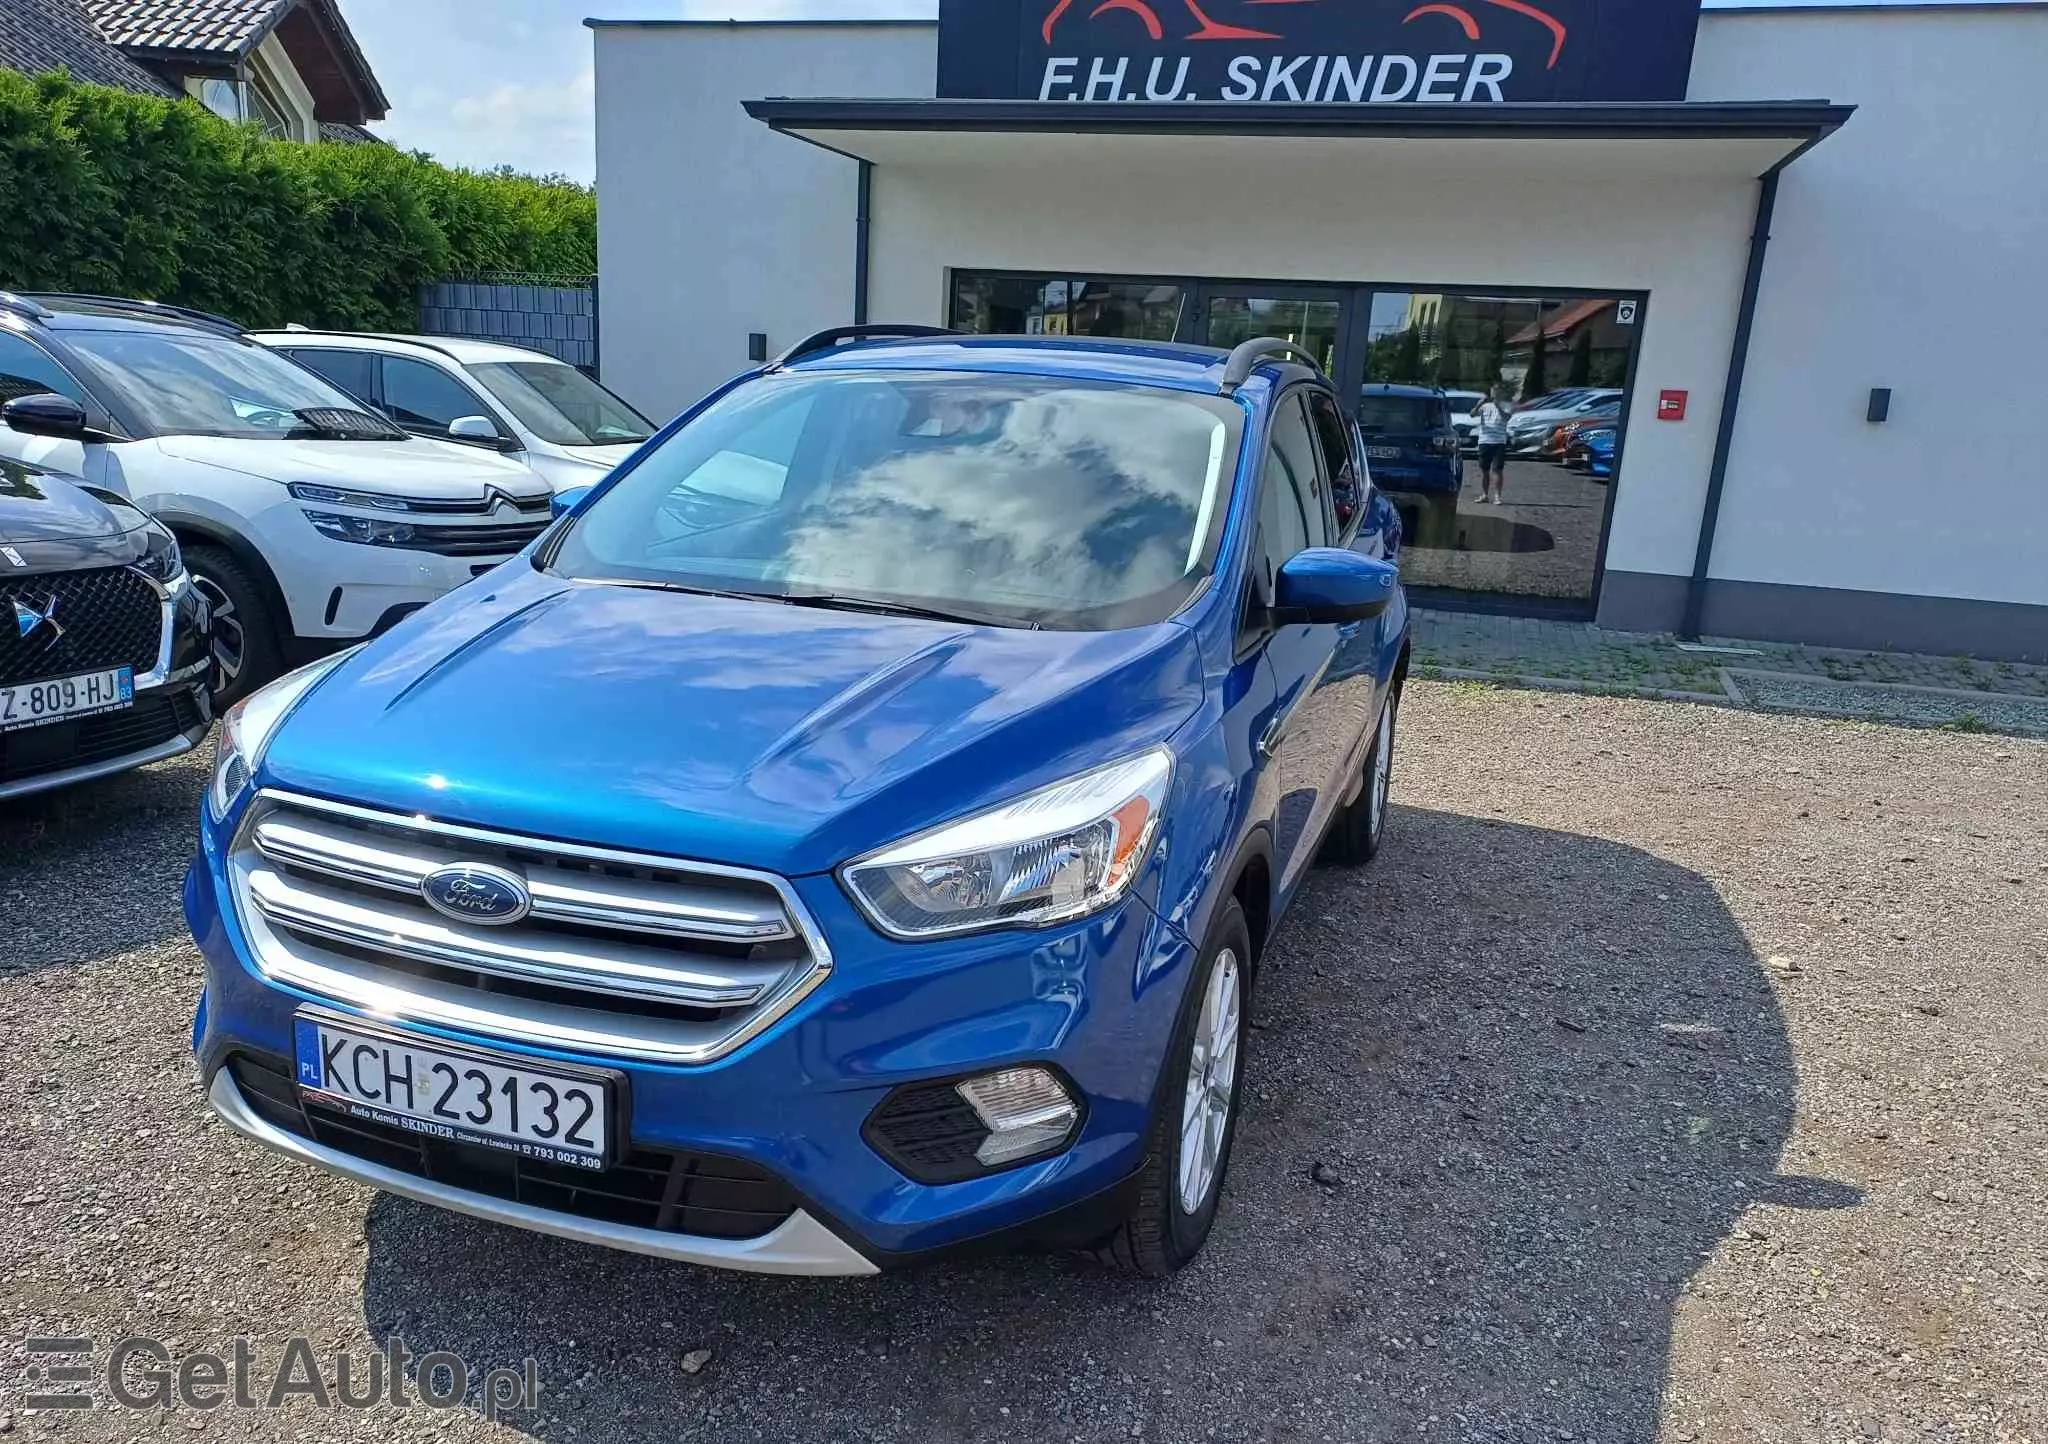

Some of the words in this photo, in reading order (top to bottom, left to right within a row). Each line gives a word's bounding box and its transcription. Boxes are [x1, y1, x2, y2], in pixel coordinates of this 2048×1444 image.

[1038, 57, 1197, 101] F.H.U.
[1221, 54, 1513, 101] SKINDER
[444, 879, 498, 912] Ford
[301, 1062, 319, 1080] PL
[321, 1033, 414, 1110] KCH
[431, 1062, 595, 1148] 23132
[351, 1104, 370, 1118] Auto
[401, 1117, 454, 1139] SKINDER
[534, 1146, 554, 1159] 793
[557, 1152, 578, 1164] 002
[580, 1156, 601, 1169] 309
